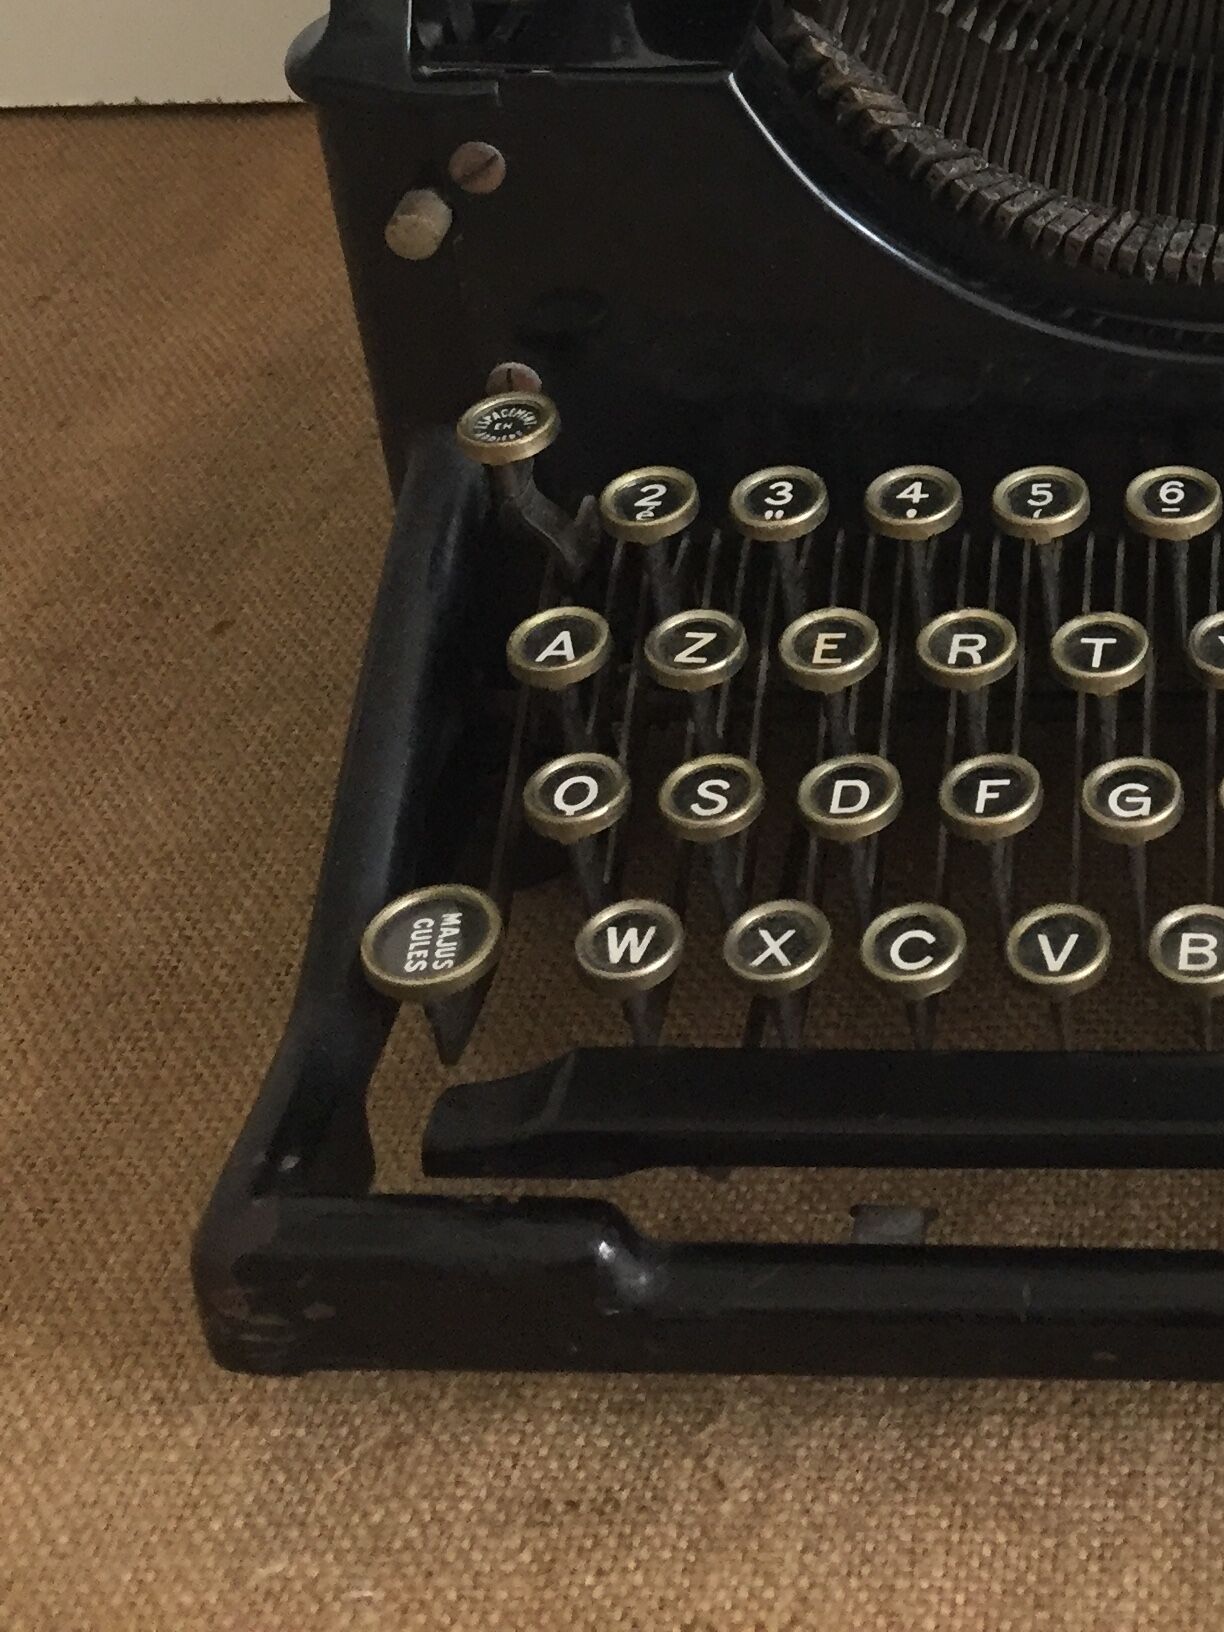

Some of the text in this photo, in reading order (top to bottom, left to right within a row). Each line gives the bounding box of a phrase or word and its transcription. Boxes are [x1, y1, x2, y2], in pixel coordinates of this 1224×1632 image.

[634, 484, 667, 507] 2
[764, 481, 793, 506] 3
[896, 481, 930, 504] 4
[1026, 483, 1054, 506] 5
[1158, 480, 1185, 505] 6
[534, 630, 575, 663] A
[673, 631, 718, 664] Z
[811, 632, 847, 664] E
[946, 633, 988, 666] R
[1080, 637, 1117, 668] T
[552, 775, 599, 816] Q
[689, 778, 731, 817] S
[828, 778, 871, 814] D
[974, 778, 1011, 814] F
[1107, 783, 1152, 818] G
[403, 917, 435, 973] CULES
[431, 912, 463, 970] MAJUS
[606, 926, 657, 966] W
[749, 928, 797, 968] X
[889, 929, 937, 971] C
[1037, 933, 1080, 973] V
[1178, 932, 1218, 971] B
